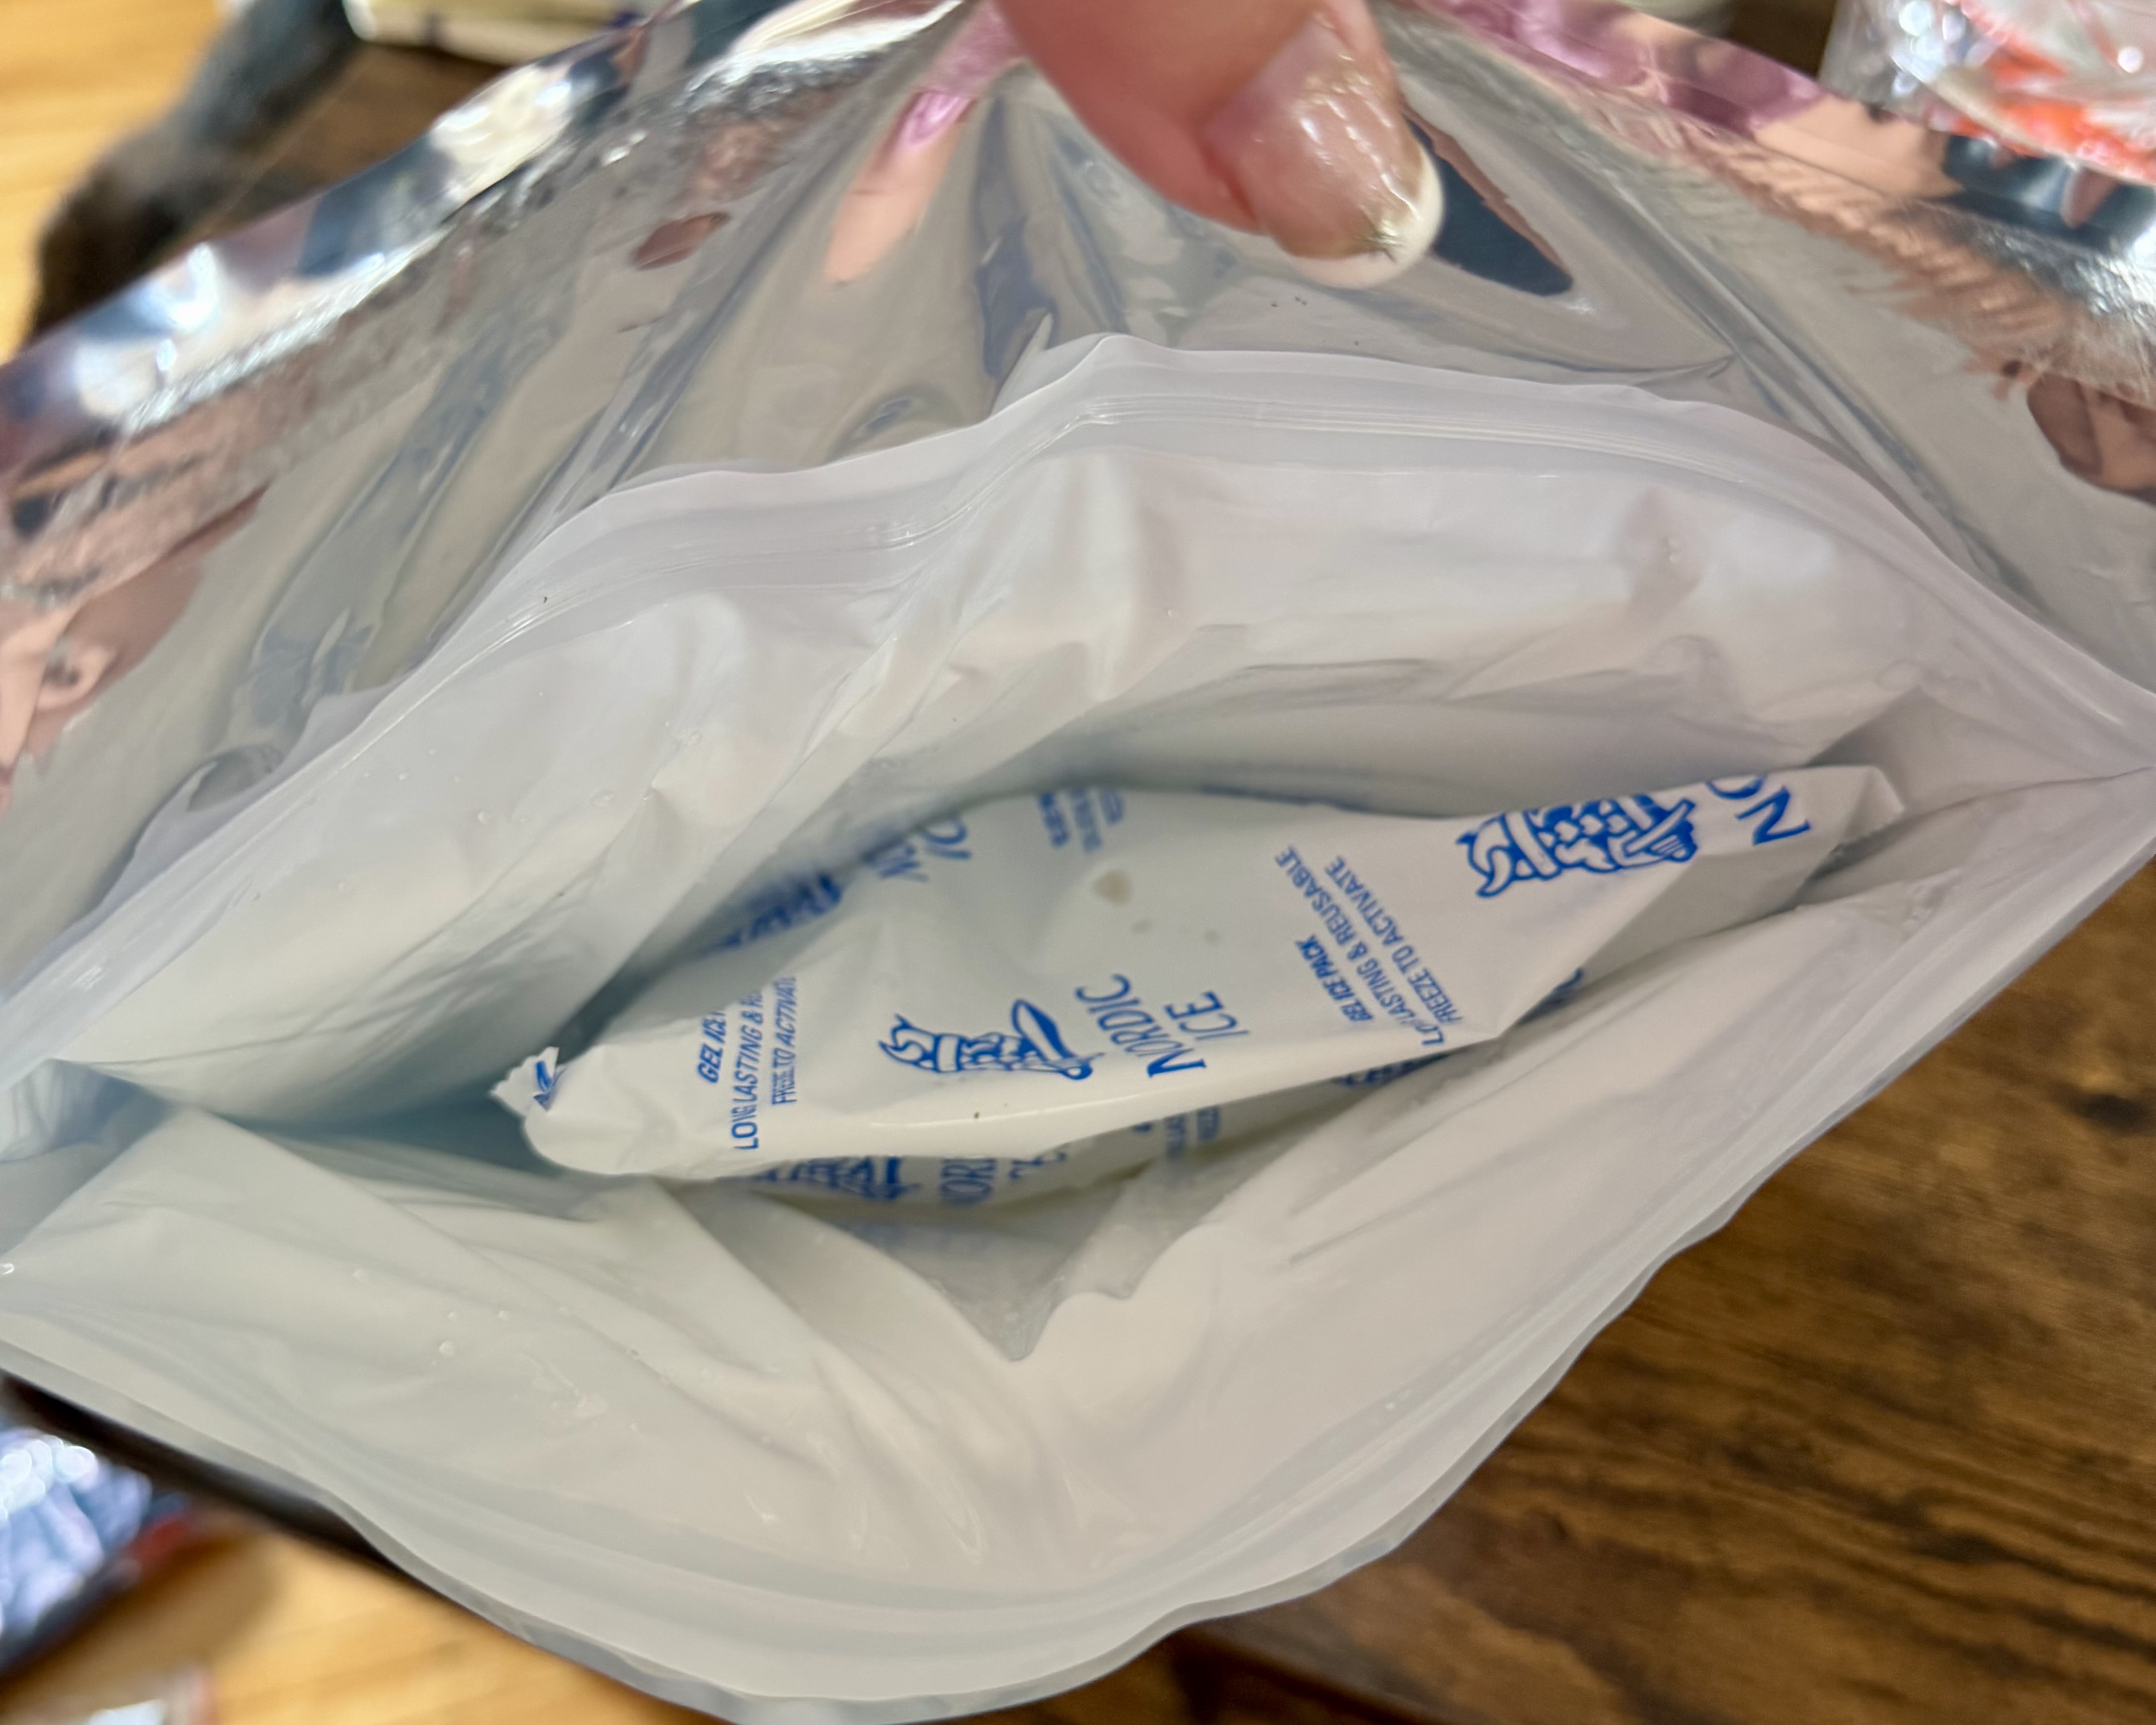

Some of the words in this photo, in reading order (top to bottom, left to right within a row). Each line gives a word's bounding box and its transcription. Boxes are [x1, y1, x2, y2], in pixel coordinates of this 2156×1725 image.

[1275, 846, 1357, 947] REUSABLE
[1325, 857, 1404, 947] ACTIVATE
[1295, 934, 1337, 979] PACK
[1346, 940, 1369, 962] &
[1391, 945, 1419, 975] TO
[775, 976, 797, 1047] ACTIVAT
[1356, 957, 1416, 1020] LASTING
[1408, 968, 1462, 1025] FREEZE
[741, 1011, 763, 1025] &
[1075, 974, 1207, 1078] NORDIC
[1163, 991, 1250, 1041] ICE
[697, 1044, 723, 1084] GEL
[733, 1026, 762, 1104] LASTING
[772, 1048, 795, 1068] TO
